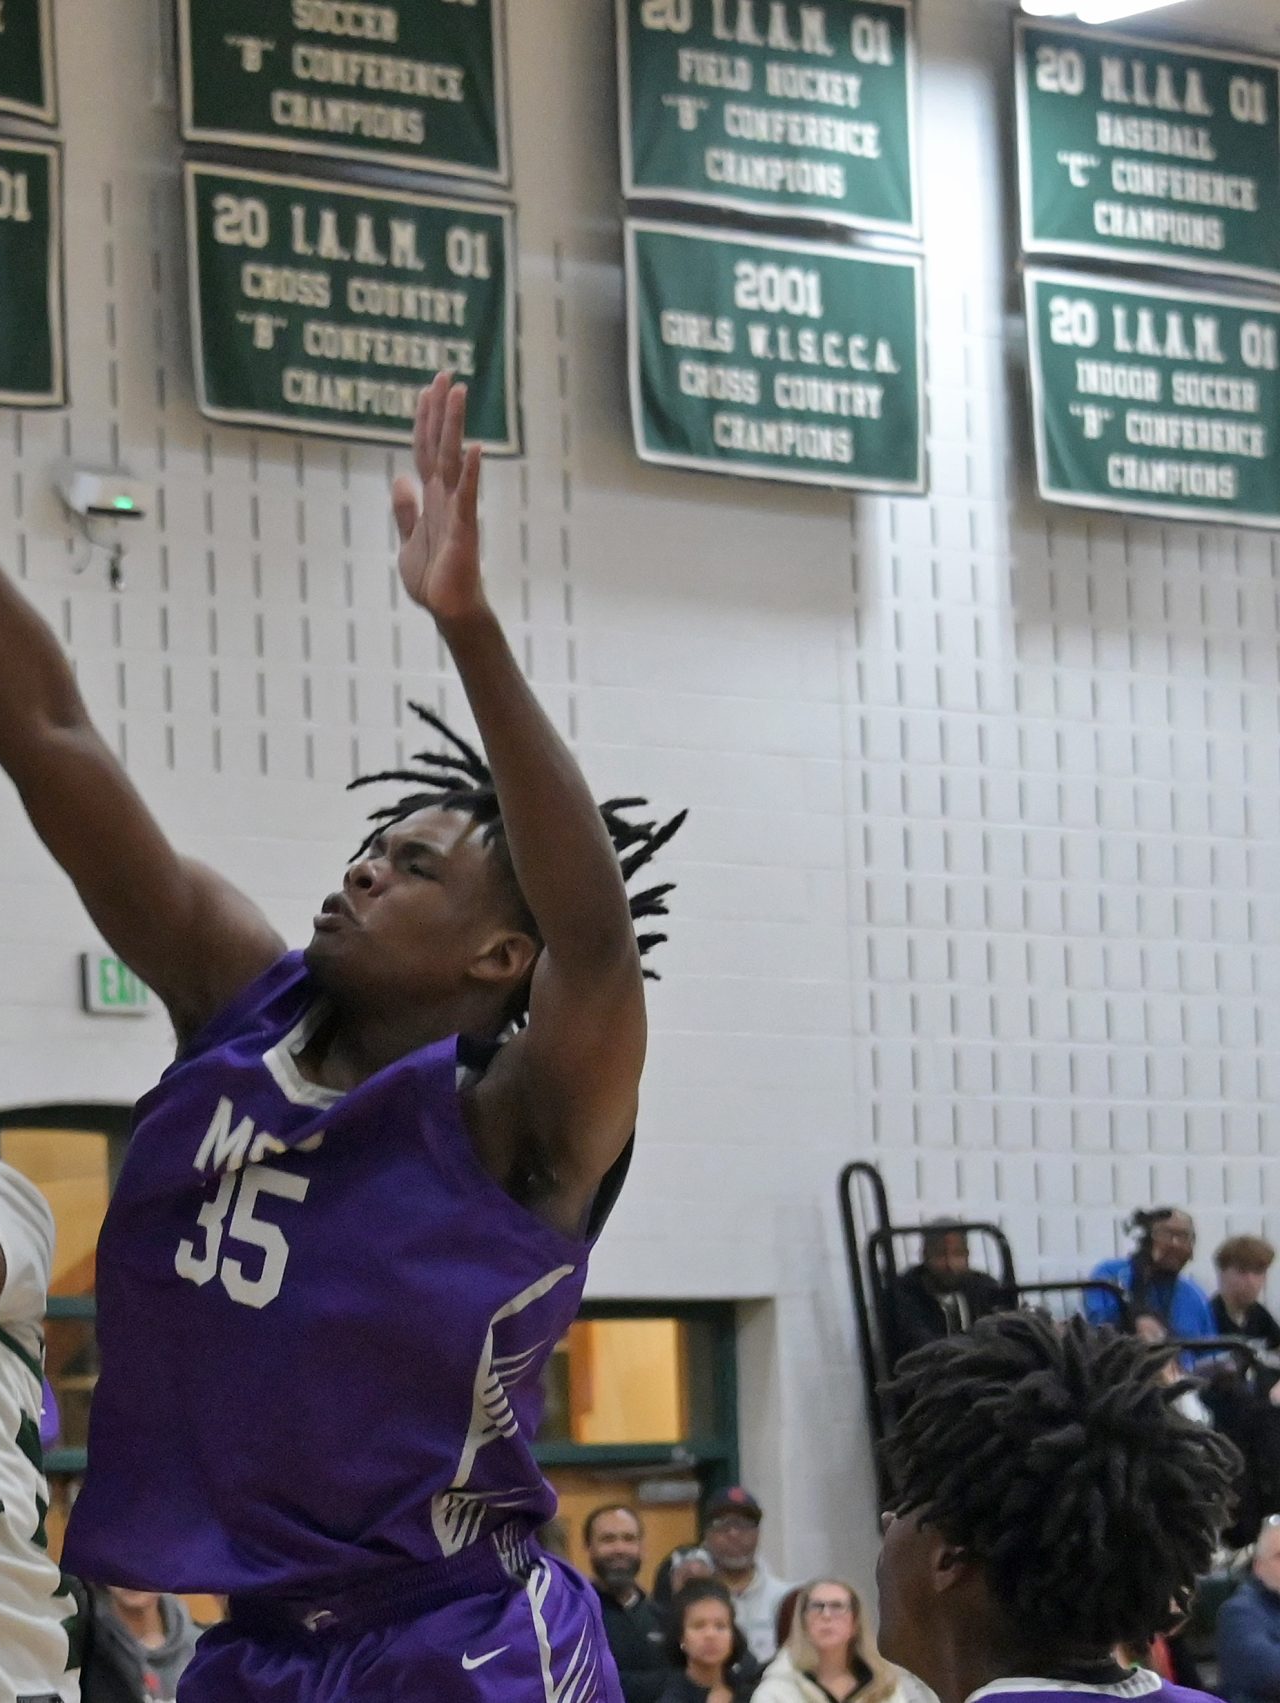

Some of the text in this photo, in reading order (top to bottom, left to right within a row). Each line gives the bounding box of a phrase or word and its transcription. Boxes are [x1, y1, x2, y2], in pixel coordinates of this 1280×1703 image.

[292, 0, 398, 43] SOCCER
[851, 14, 894, 66] 01
[291, 43, 464, 102] CONFERENCE
[677, 48, 862, 109] FIELD HOCKEY
[1035, 45, 1086, 97] 20
[1227, 74, 1269, 125] 01
[271, 89, 425, 144] CHAMPIONS
[723, 103, 882, 159] CONFERENCE
[1095, 110, 1217, 162] BASEBALL
[705, 148, 847, 200] CHAMPIONS
[1111, 157, 1258, 211] CONFERENCE
[212, 193, 269, 248] 20
[446, 226, 491, 280] 01
[1092, 199, 1225, 250] CHAMPIONS
[241, 262, 468, 327] CROSS COUNTRY
[733, 259, 824, 319] 2001
[303, 321, 475, 376] CONFERENCE
[660, 309, 734, 354] GIRLS
[1048, 295, 1100, 349] 20
[1239, 319, 1277, 371] 01
[282, 366, 420, 418] CHAMPION
[679, 359, 884, 421] CROSS COUNTRY
[1075, 357, 1259, 413] INDOOR SOCCER
[712, 411, 854, 464] CHAMPIONS
[1125, 408, 1266, 460] CONFERENCE
[1107, 452, 1237, 501] CHAMPIONS
[174, 1164, 310, 1310] 35
